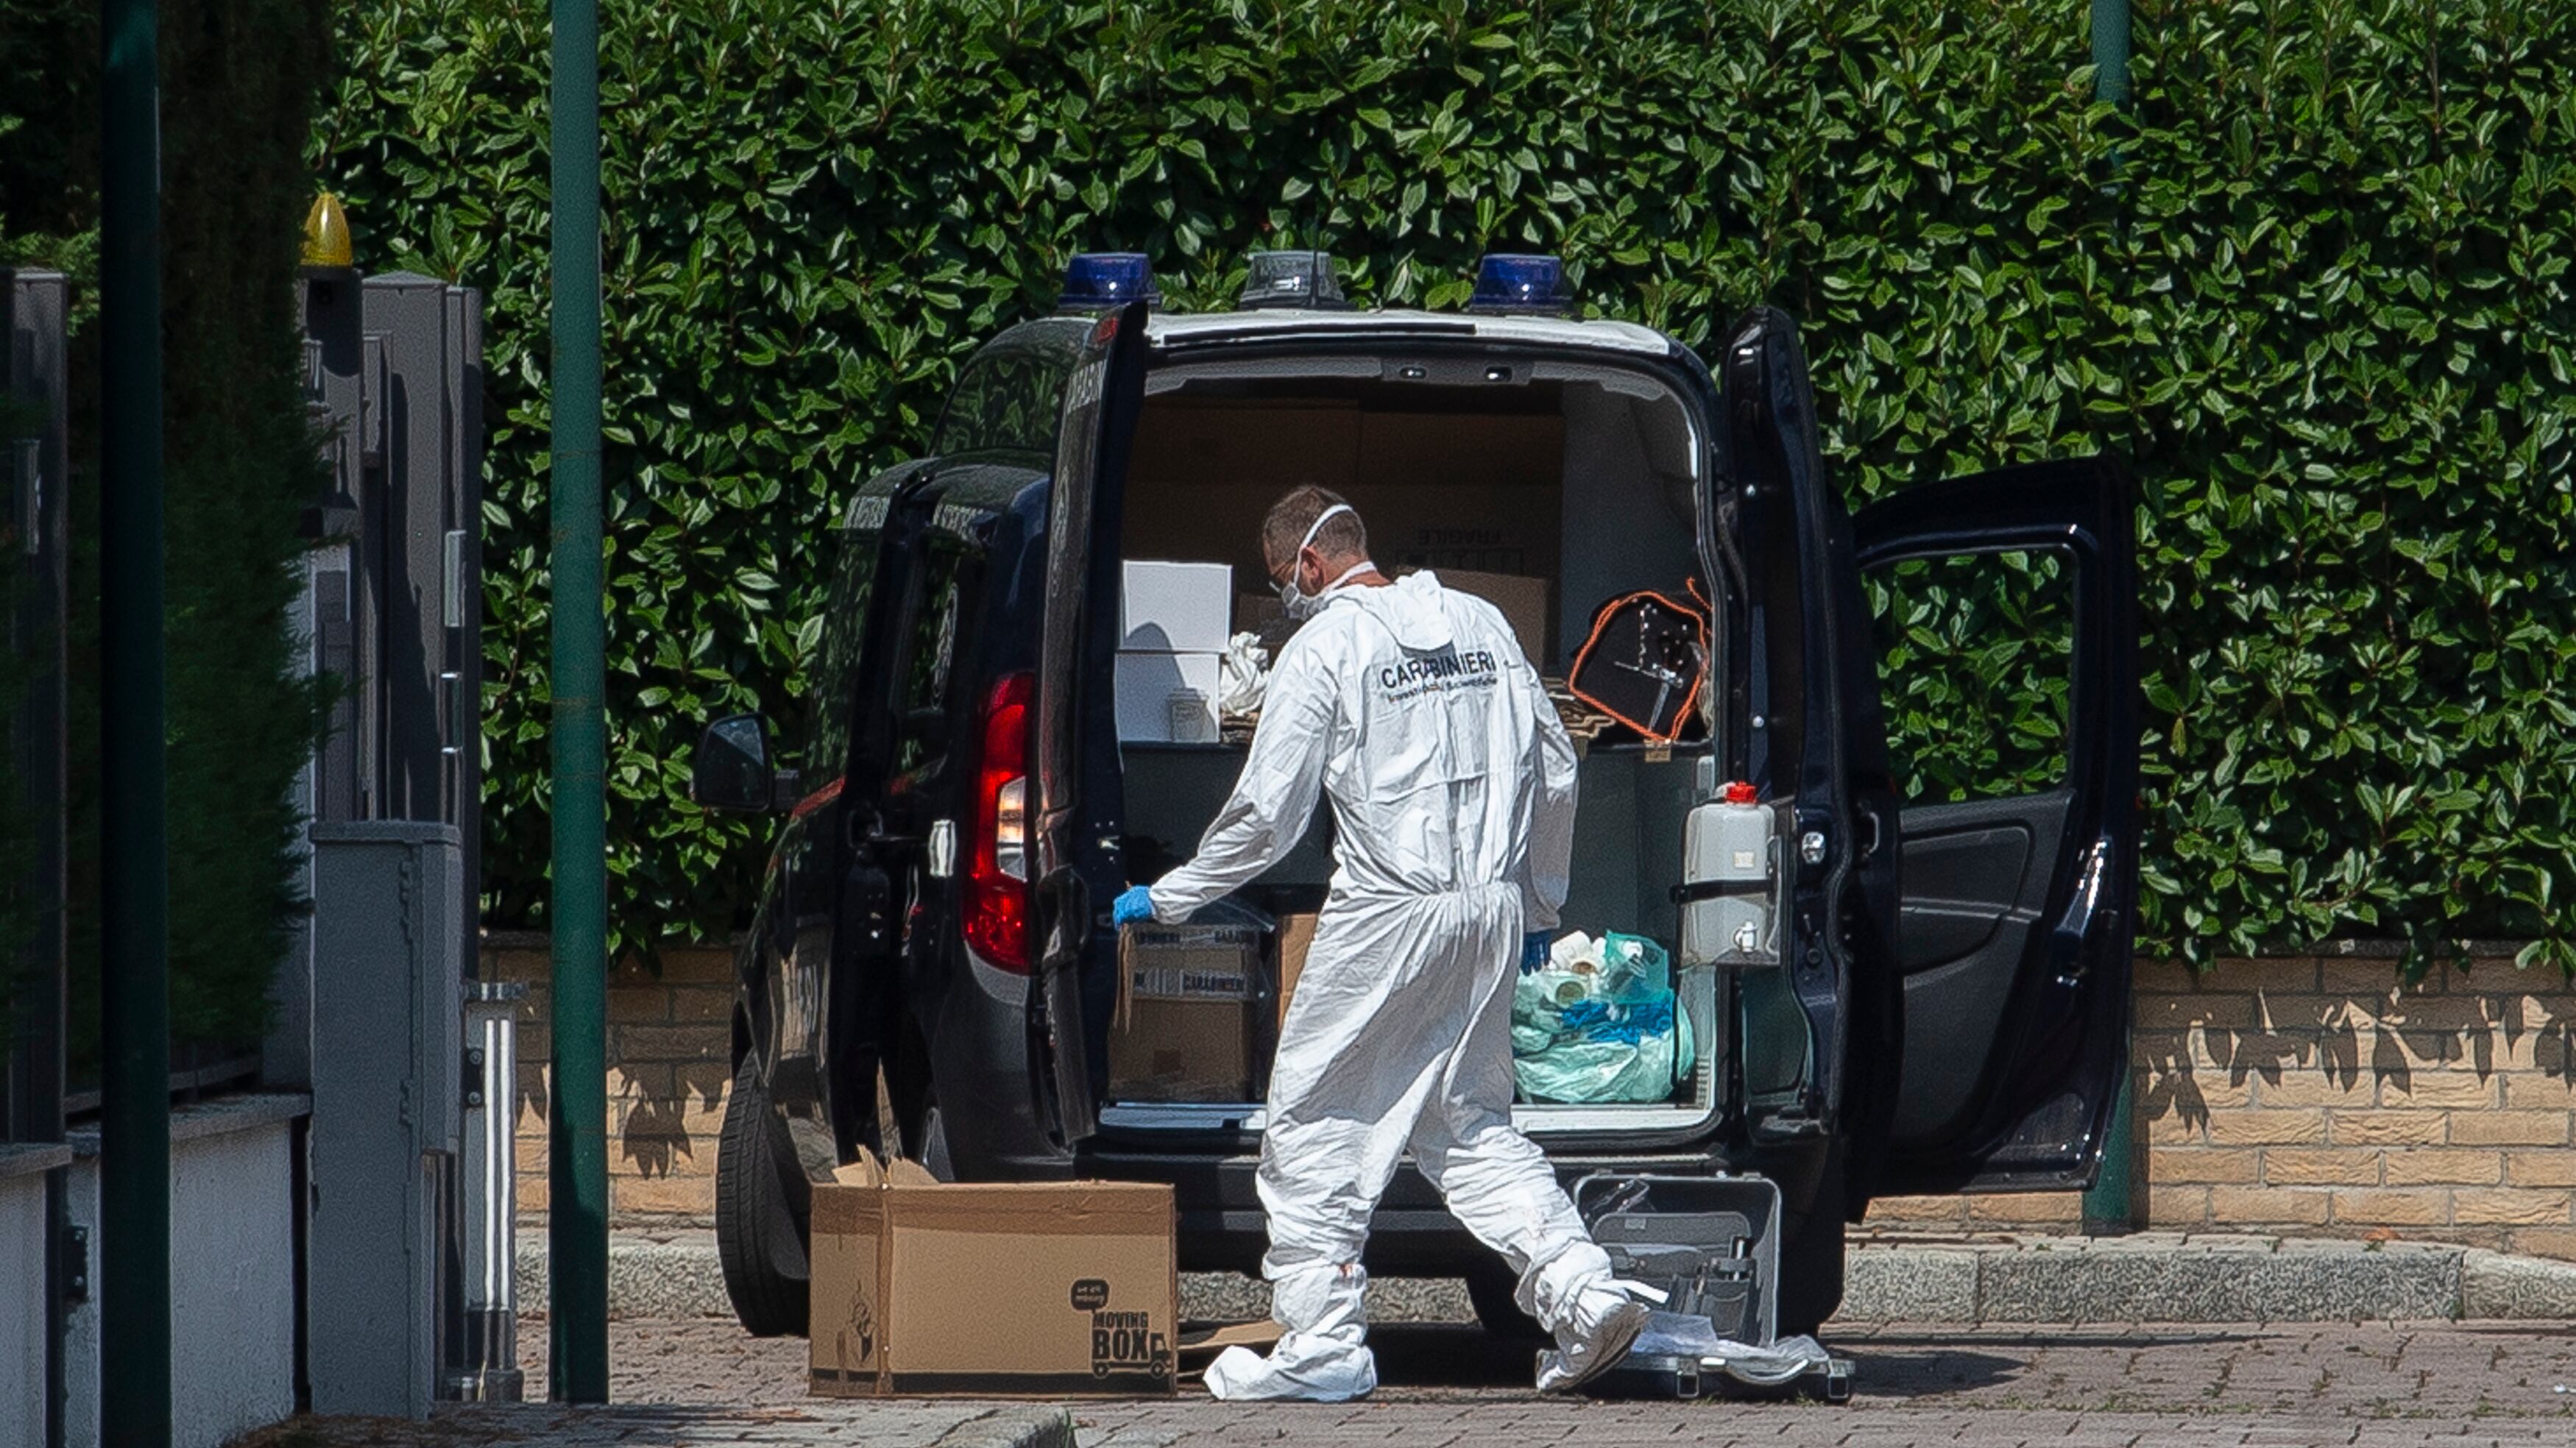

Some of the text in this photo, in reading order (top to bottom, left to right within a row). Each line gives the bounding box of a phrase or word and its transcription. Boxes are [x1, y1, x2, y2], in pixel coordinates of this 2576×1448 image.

[1381, 650, 1497, 688] CARABINIERI
[1094, 1311, 1148, 1328] MOVING
[1093, 1329, 1148, 1360] BOX
